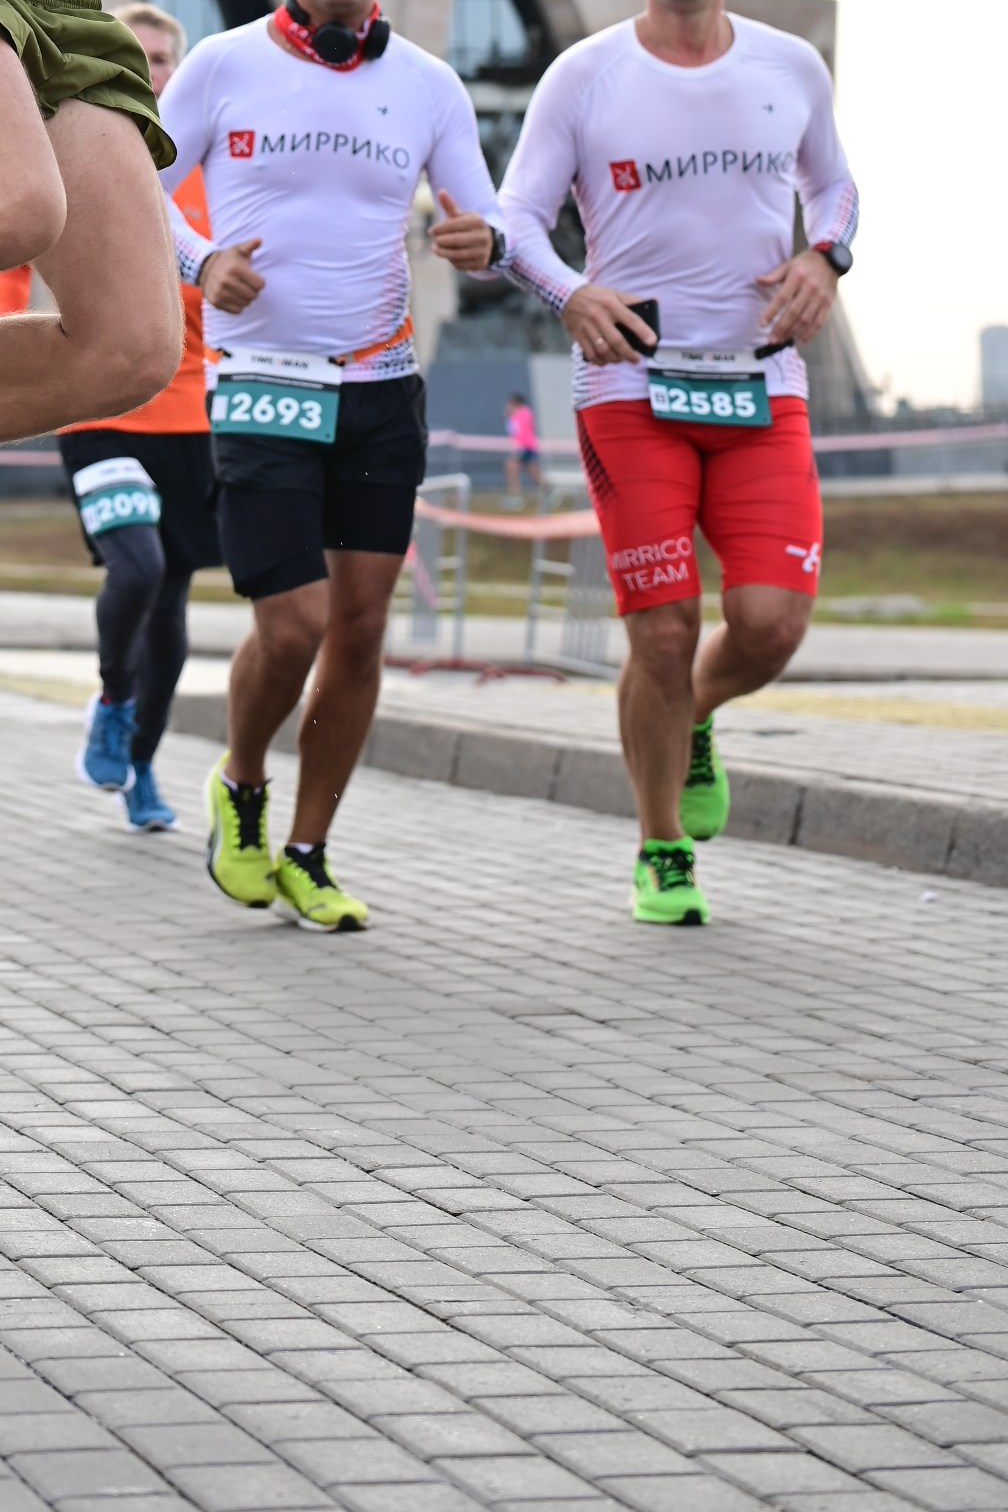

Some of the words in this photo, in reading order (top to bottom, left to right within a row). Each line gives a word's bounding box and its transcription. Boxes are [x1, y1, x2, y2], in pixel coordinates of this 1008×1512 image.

[260, 131, 411, 170] МИРРИКО
[229, 391, 323, 430] 2693
[668, 387, 757, 418] 2585
[622, 560, 690, 593] TEAM
